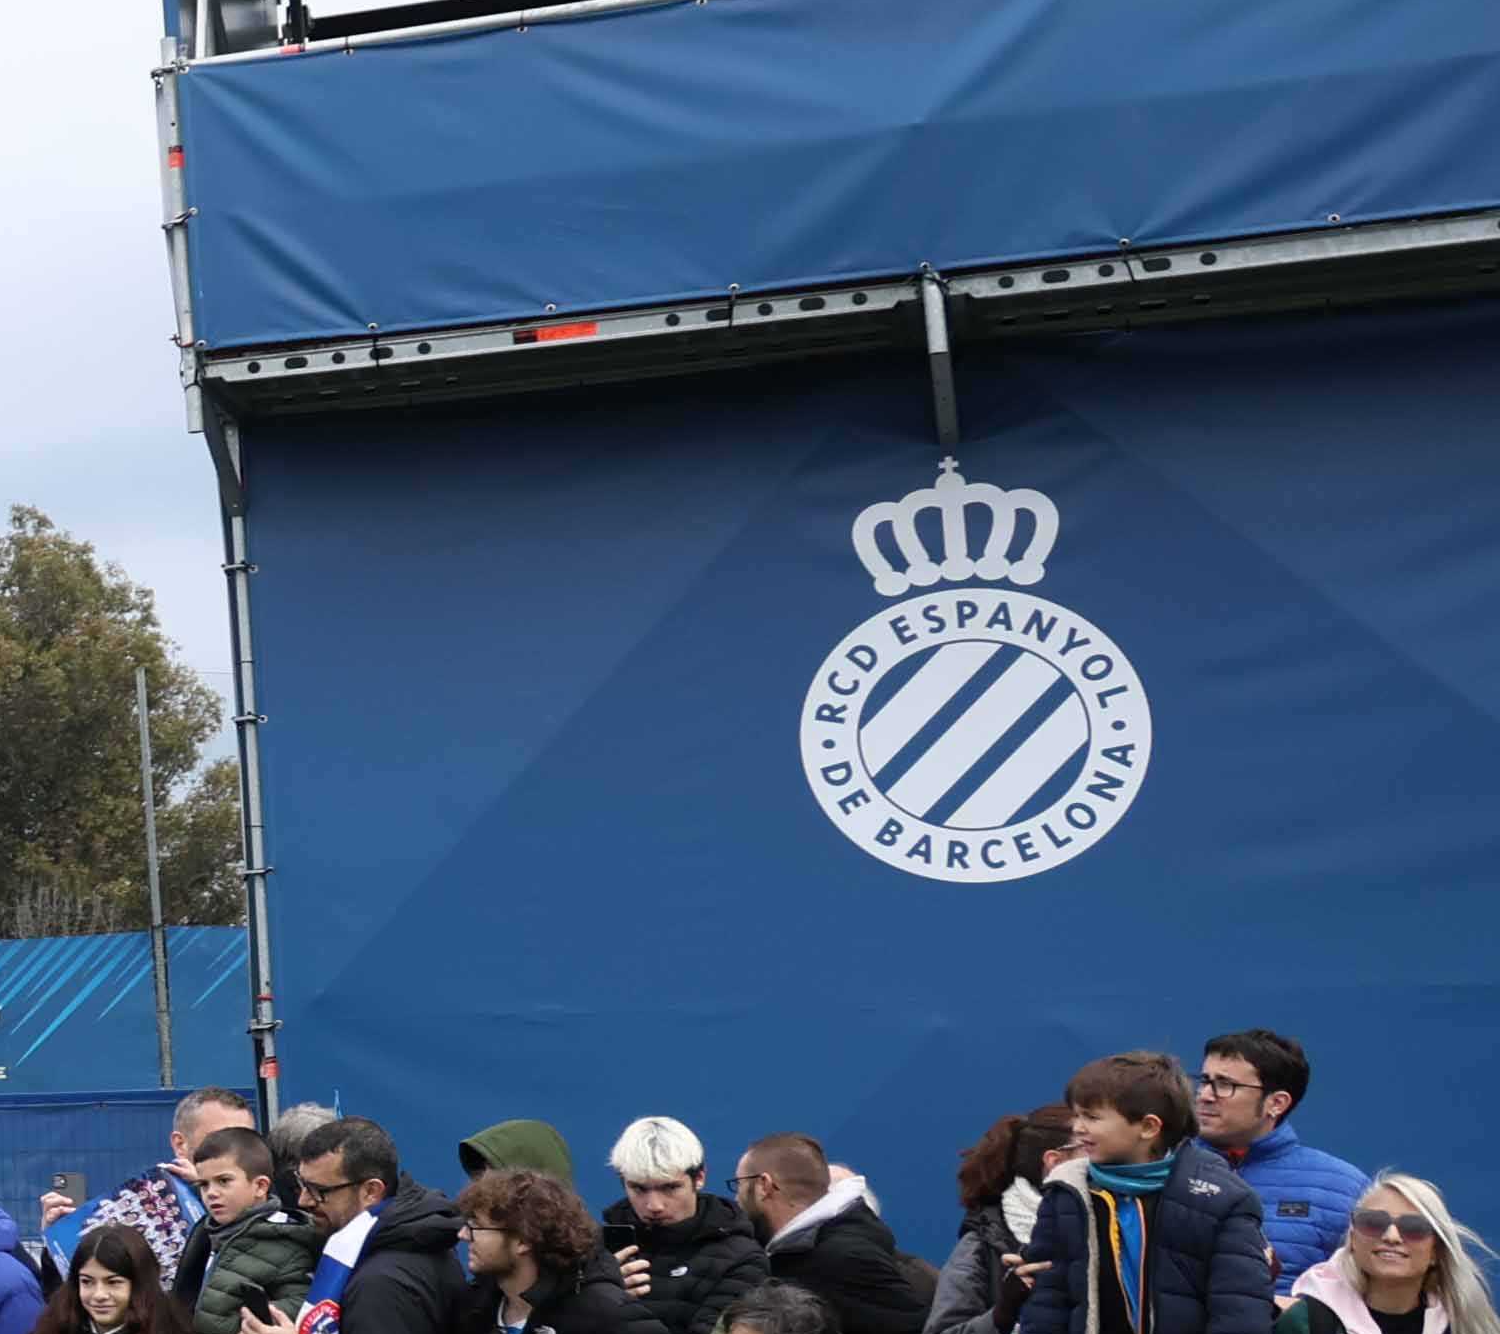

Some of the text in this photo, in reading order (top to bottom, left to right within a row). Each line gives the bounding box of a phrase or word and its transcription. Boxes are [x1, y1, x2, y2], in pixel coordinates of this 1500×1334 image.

[815, 599, 1129, 726] RCD ESPANYOL
[820, 743, 1136, 871] DE BARCELONA
